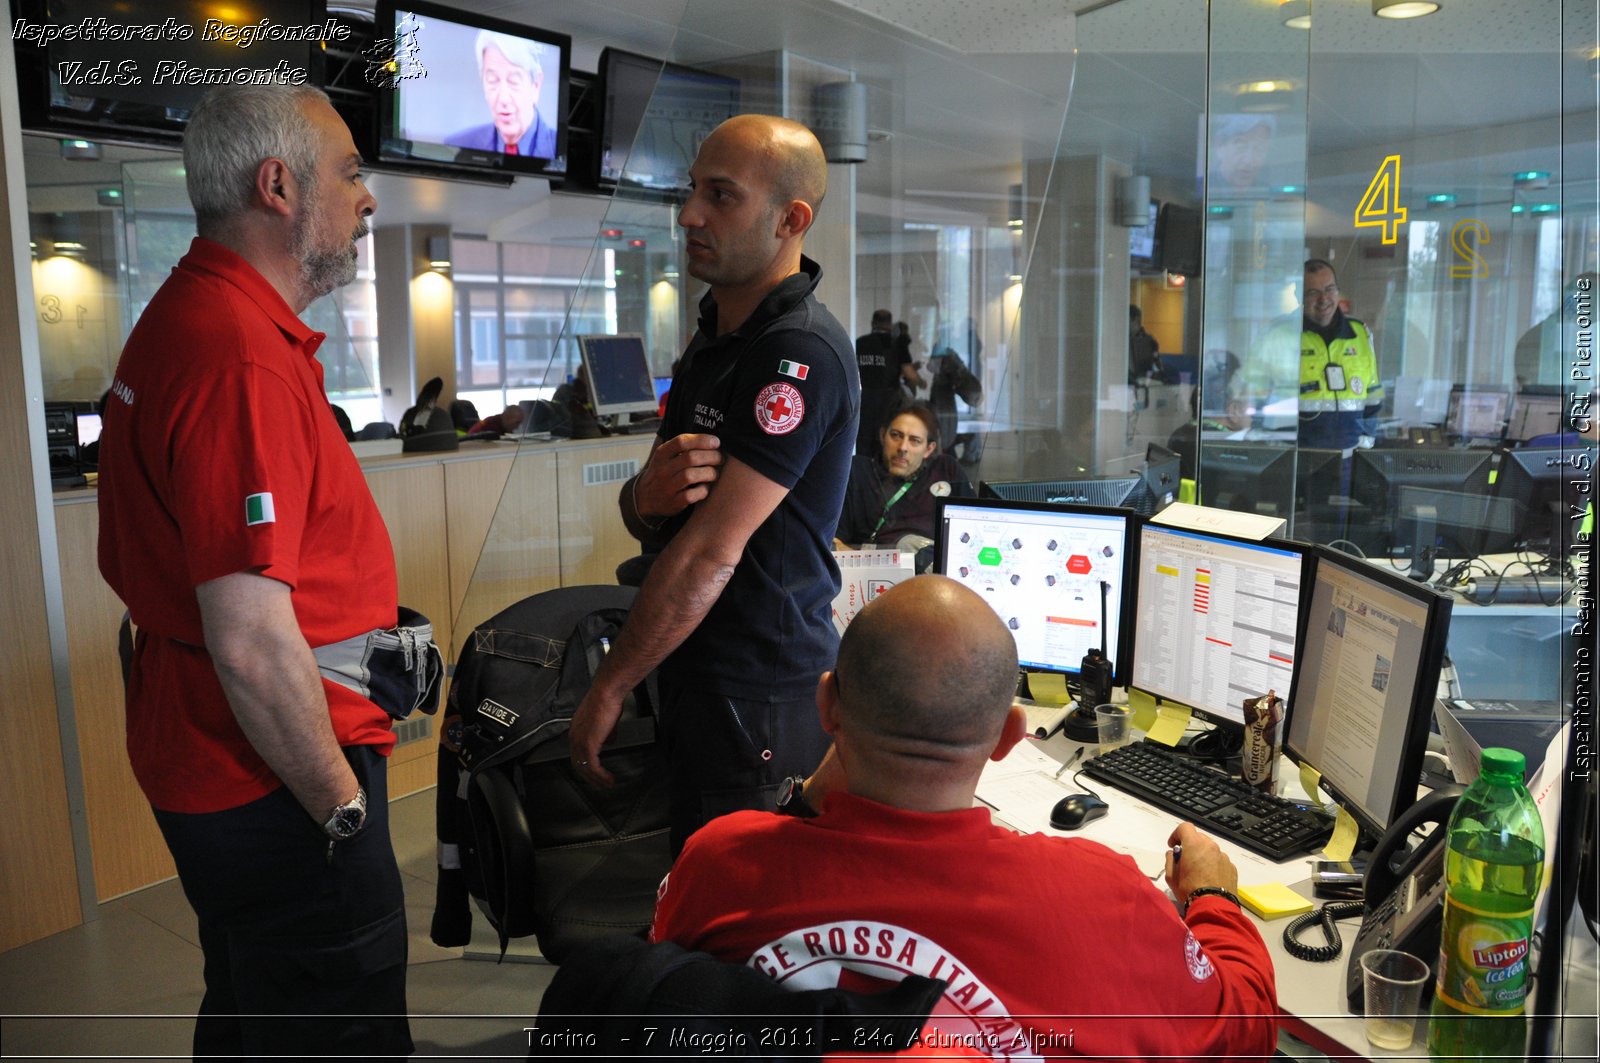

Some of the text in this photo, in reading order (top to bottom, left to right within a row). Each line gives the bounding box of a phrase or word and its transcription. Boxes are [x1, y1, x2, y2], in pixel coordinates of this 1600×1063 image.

[1354, 154, 1408, 246] 4
[40, 294, 63, 325] 3
[481, 702, 508, 720] DAVIDE
[1248, 721, 1264, 781] Grancereale
[753, 942, 797, 979] CE
[803, 926, 918, 967] ROSSA
[1477, 944, 1525, 966] Lipton
